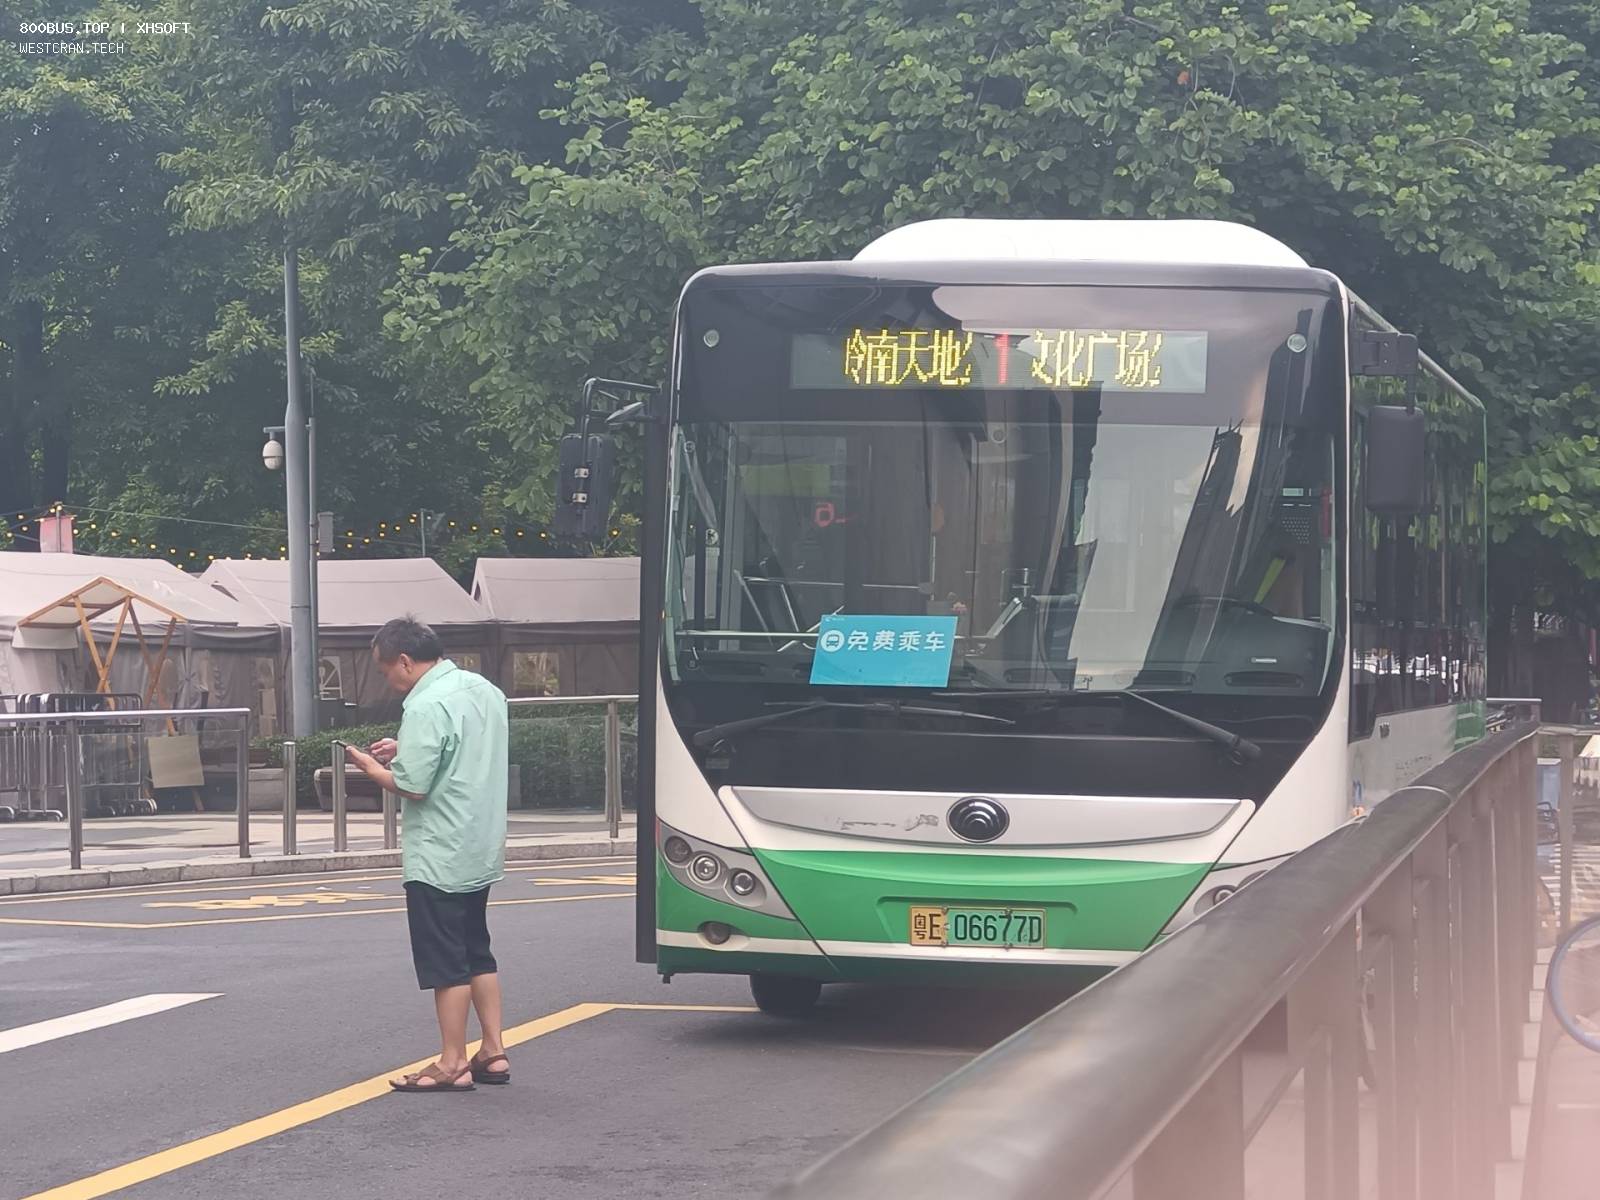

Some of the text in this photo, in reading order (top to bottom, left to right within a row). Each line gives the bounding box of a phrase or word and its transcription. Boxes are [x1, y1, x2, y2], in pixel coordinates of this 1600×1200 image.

[994, 330, 1009, 385] 1
[847, 629, 946, 652] 免费乘车
[913, 913, 1042, 943] 粤E 06677D
